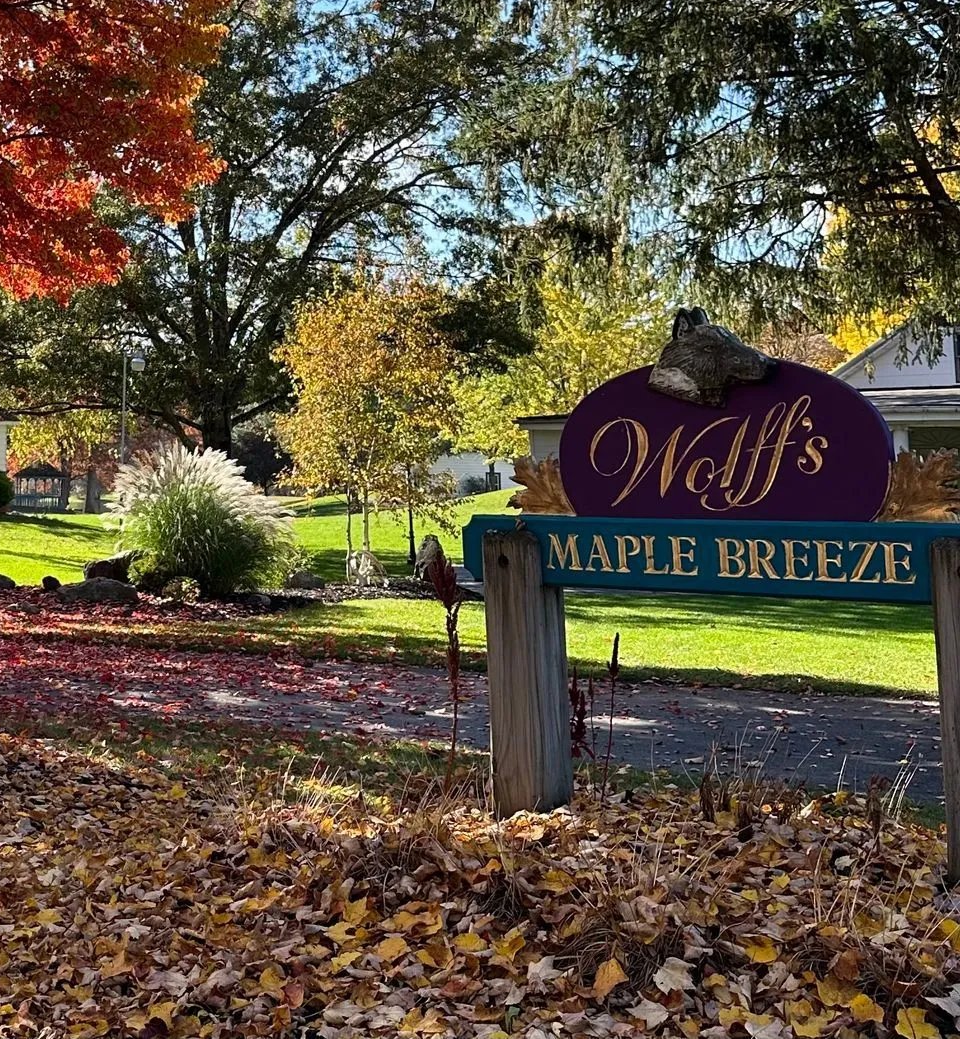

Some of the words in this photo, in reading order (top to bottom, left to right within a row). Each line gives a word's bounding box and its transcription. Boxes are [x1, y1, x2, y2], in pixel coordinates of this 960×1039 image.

[589, 394, 829, 511] Wolff's
[546, 533, 699, 576] MAPLE
[714, 537, 917, 585] BREEZE
